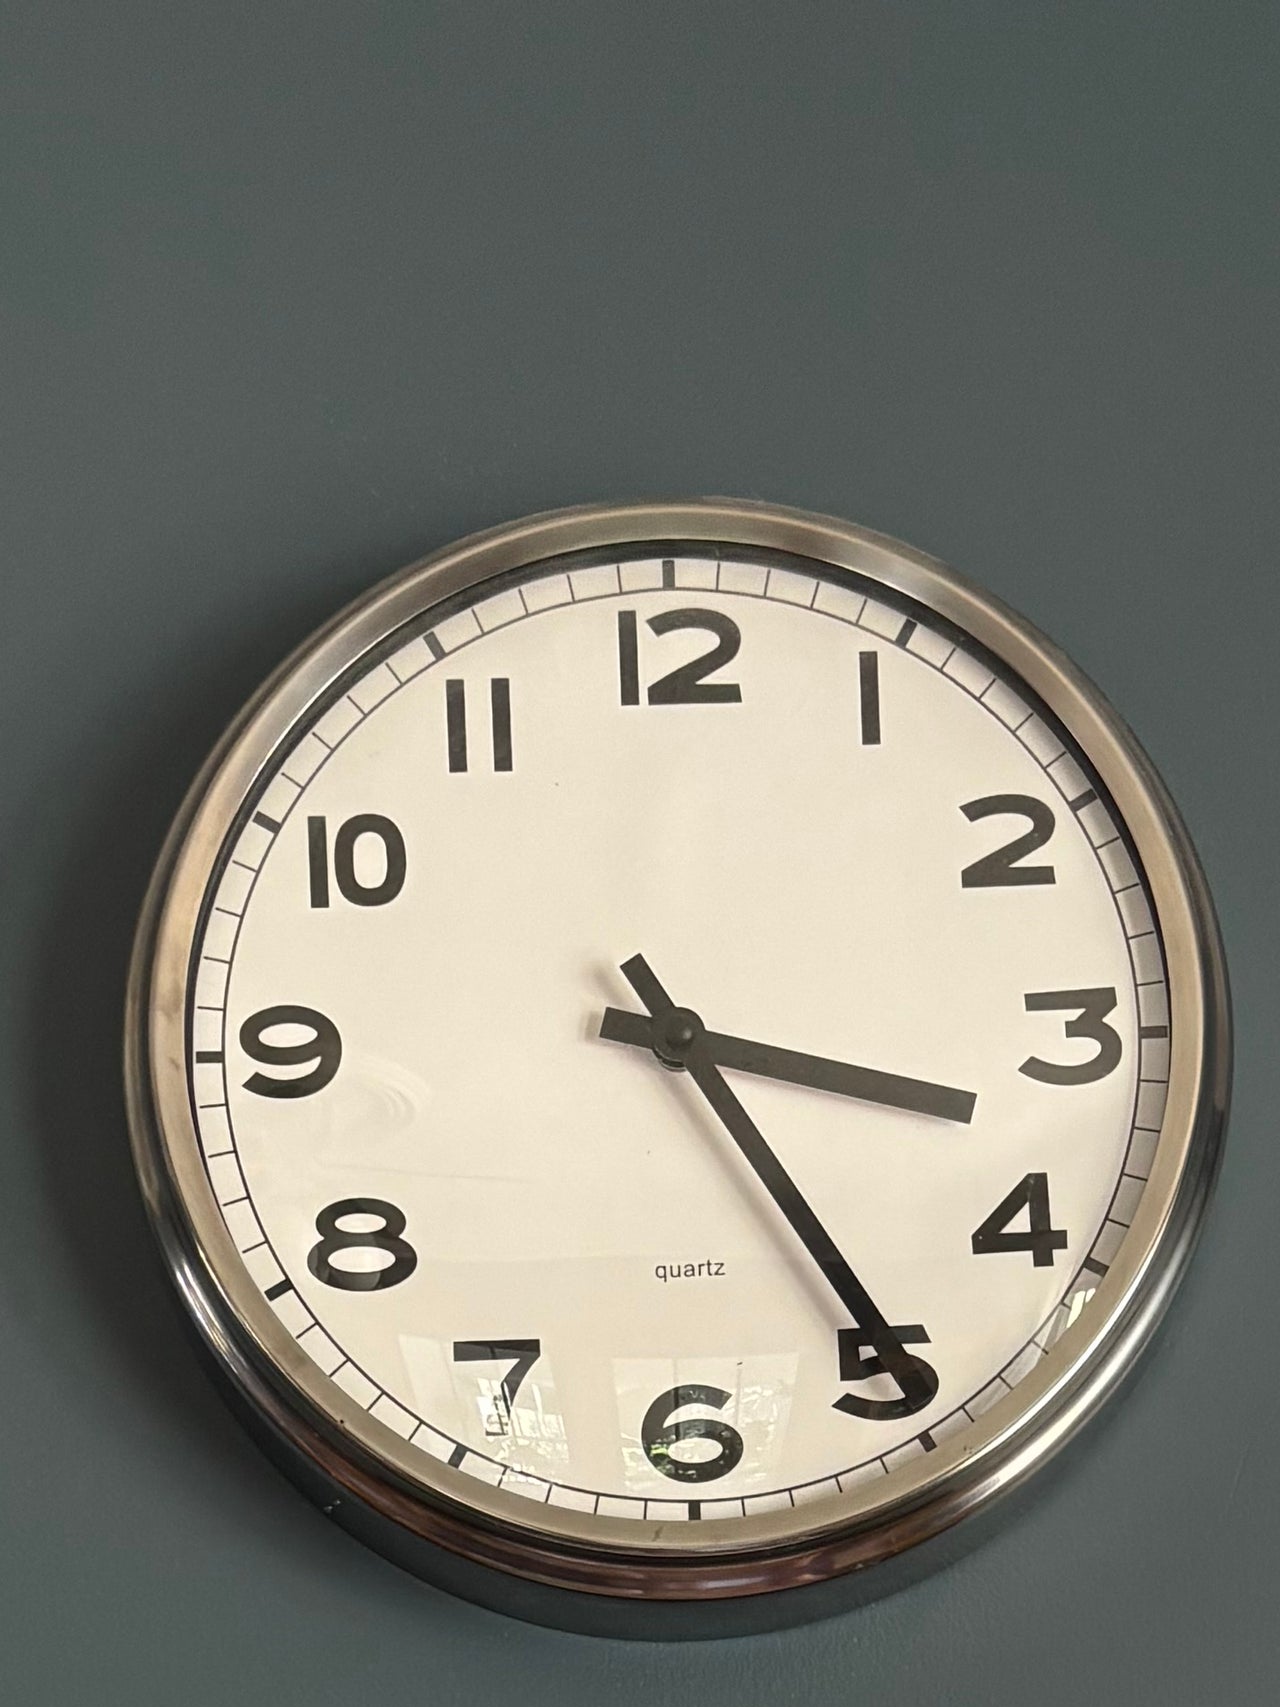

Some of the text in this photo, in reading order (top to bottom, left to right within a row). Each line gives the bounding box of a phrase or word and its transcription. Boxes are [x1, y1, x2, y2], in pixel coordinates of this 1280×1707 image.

[618, 608, 743, 706] 12
[858, 650, 882, 746] 1
[445, 677, 514, 773] 11
[306, 813, 408, 909] 10
[960, 793, 1058, 888] 2
[238, 1005, 343, 1099] 9
[1017, 986, 1123, 1086] 3
[306, 1197, 418, 1292] 8
[970, 1172, 1069, 1268] 4
[654, 1258, 726, 1283] quartz
[452, 1338, 542, 1437] 7
[831, 1324, 940, 1422] 5
[640, 1384, 746, 1484] 6
